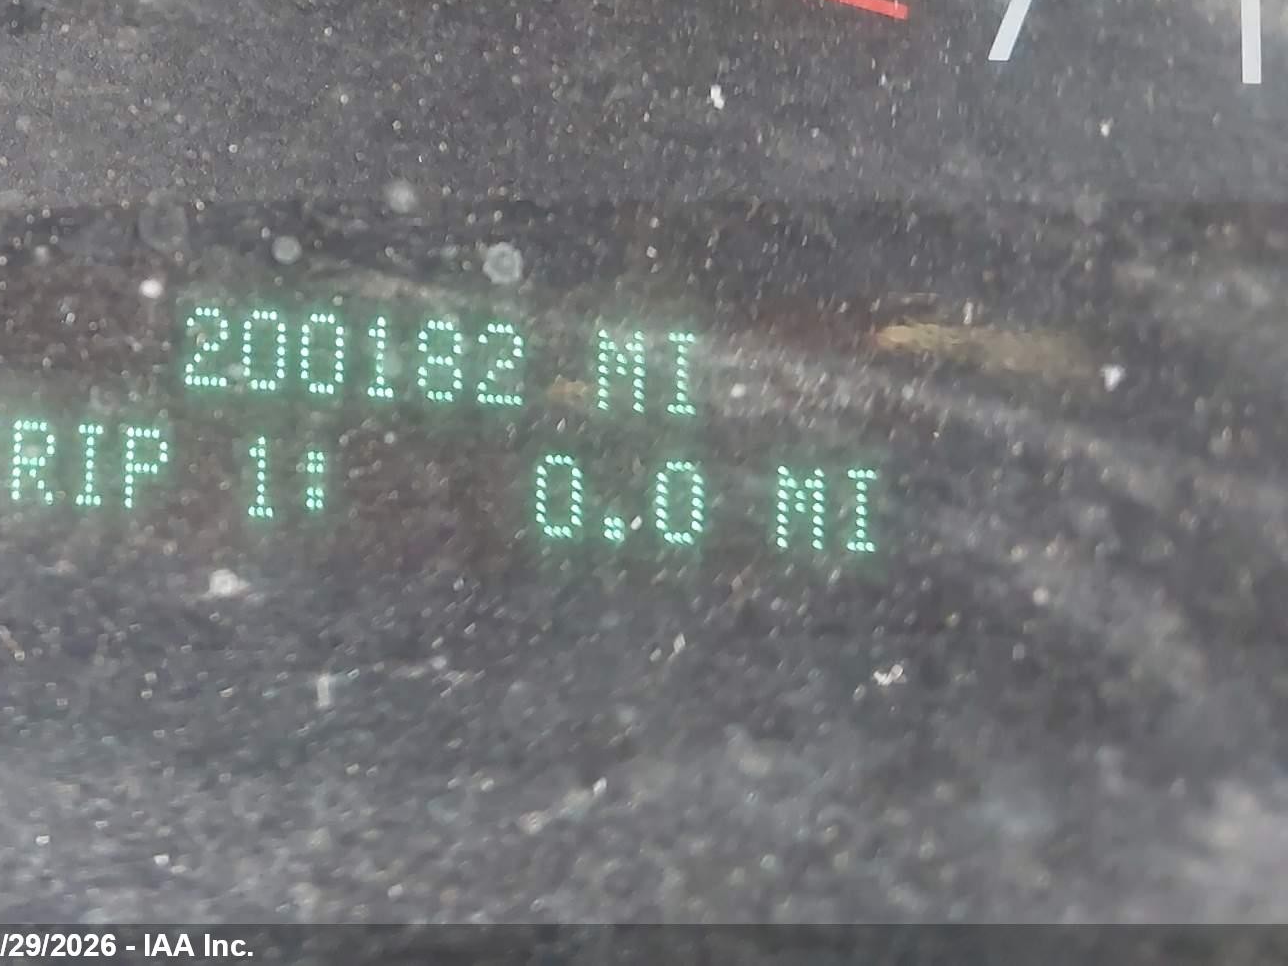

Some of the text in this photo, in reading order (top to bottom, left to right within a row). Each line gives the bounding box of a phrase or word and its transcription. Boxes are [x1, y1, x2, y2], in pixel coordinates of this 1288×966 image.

[183, 307, 697, 415] 200182 MI
[248, 436, 328, 518] 1:
[534, 454, 705, 545] 0.0
[774, 464, 878, 552] MI
